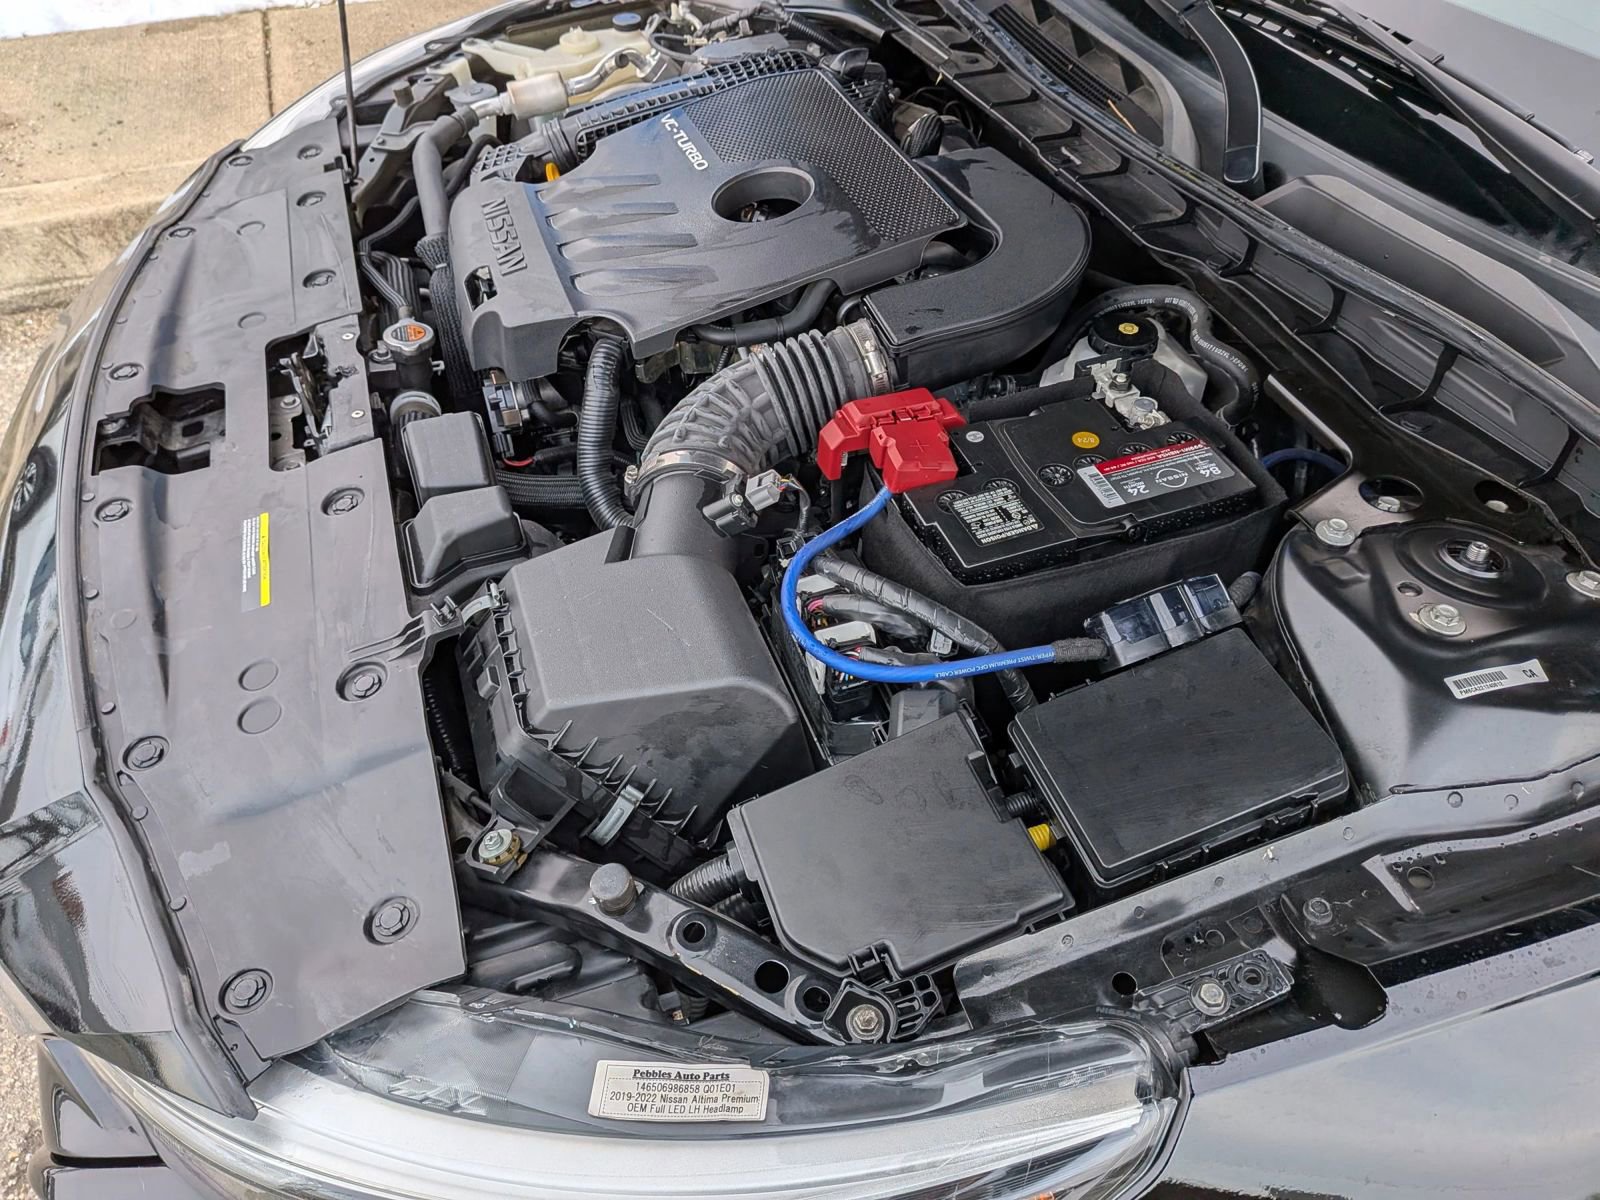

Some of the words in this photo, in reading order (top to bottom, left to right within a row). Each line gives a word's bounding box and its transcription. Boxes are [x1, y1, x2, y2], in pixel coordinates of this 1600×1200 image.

[661, 113, 709, 170] VC-TURBO
[481, 197, 528, 277] NISSAN
[1155, 470, 1189, 484] NISSAN
[1200, 465, 1222, 478] 84
[1128, 484, 1150, 496] 24
[976, 663, 989, 671] OFC
[990, 658, 1017, 669] PREMIUM
[953, 667, 976, 676] POWER
[1522, 669, 1539, 679] CA
[633, 1069, 672, 1080] Pebbles
[675, 1071, 701, 1080] Auto
[703, 1072, 730, 1081] Parts
[636, 1082, 700, 1094] 146506986858
[609, 1091, 657, 1103] 2019-2022
[660, 1094, 688, 1103] Nissan
[691, 1094, 719, 1103] Altima
[721, 1094, 759, 1103] Premium
[627, 1103, 647, 1112] OEM
[650, 1104, 666, 1114] Full
[668, 1105, 685, 1113] LED
[689, 1105, 700, 1114] LH
[703, 1104, 744, 1114] Headlamp
